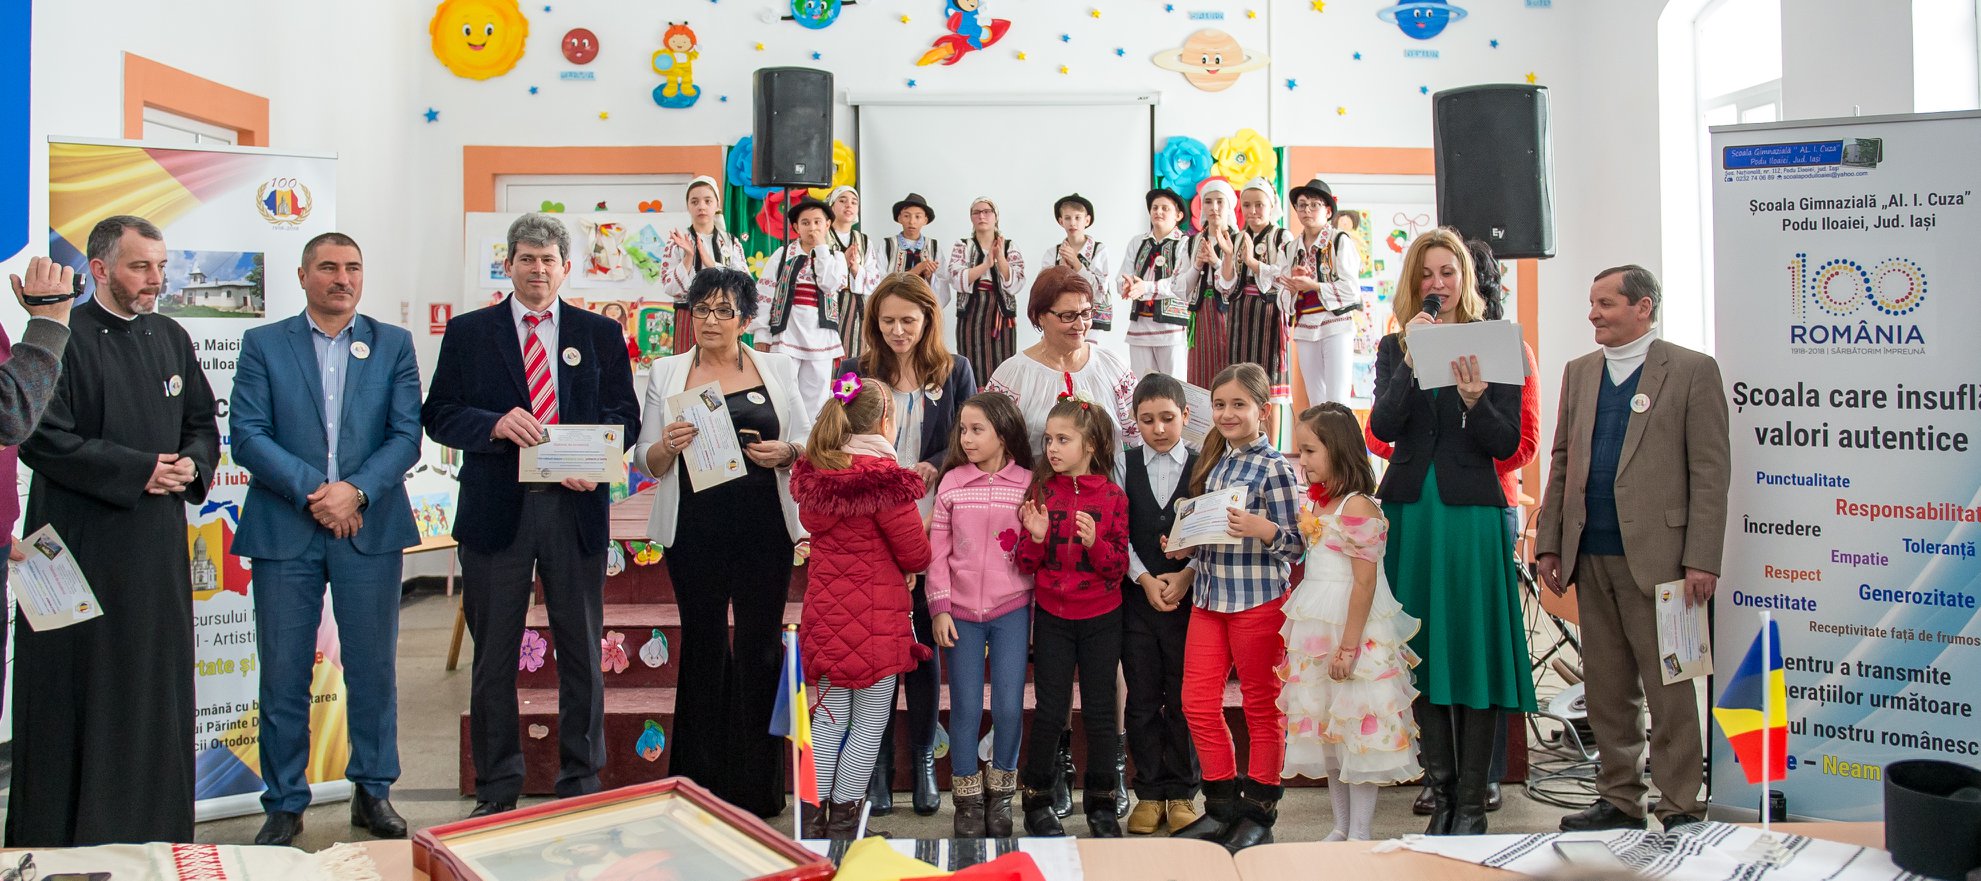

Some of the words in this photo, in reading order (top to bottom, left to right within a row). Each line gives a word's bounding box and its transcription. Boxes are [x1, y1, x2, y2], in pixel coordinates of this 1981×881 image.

[271, 177, 297, 188] 100
[1749, 197, 1795, 216] Școala
[1799, 194, 1877, 211] Gimnazială
[1913, 192, 1923, 207] I.
[1492, 227, 1505, 239] EV
[1782, 217, 1817, 232] Podu
[1822, 215, 1869, 233] Iloaiei,
[1873, 214, 1905, 229] Jud.
[1909, 213, 1937, 231] Iași
[1787, 252, 1928, 323] 100
[1790, 319, 1926, 344] ROMÂNIA
[204, 338, 243, 351] Maici
[1790, 347, 1825, 355] 1918-2018
[1831, 346, 1881, 355] SĂRBĂTORIM
[1883, 346, 1926, 355] ÎMPREUNĂ
[1732, 381, 1821, 414] Școala
[1829, 388, 1888, 410] care
[1755, 420, 1829, 447] valori
[1838, 425, 1969, 452] autentice
[1756, 471, 1851, 488] Punctualitate
[1743, 514, 1822, 537] Încredere
[1831, 549, 1889, 568] Empatie
[1902, 538, 1976, 561] Toleranță
[1764, 565, 1822, 583] Respect
[1732, 590, 1817, 612] Onestitate
[1859, 584, 1976, 609] Generozitate
[194, 609, 247, 627] cursului
[213, 629, 256, 646] Artisti
[1809, 620, 1887, 640] Receptivitate
[1890, 626, 1916, 645] față
[1918, 629, 1933, 643] de
[1937, 630, 1981, 647] frumos
[1783, 656, 1834, 674] entru
[1840, 661, 1851, 677] a
[1857, 661, 1952, 686] transmite
[195, 702, 232, 717] omână
[235, 703, 249, 712] cu
[1784, 684, 1864, 708] erațiilor
[1870, 692, 1972, 717] următoare
[206, 720, 248, 733] Părinte
[1813, 722, 1875, 744] nostru
[1881, 730, 1980, 756] românesc
[1823, 754, 1881, 781] Neam
